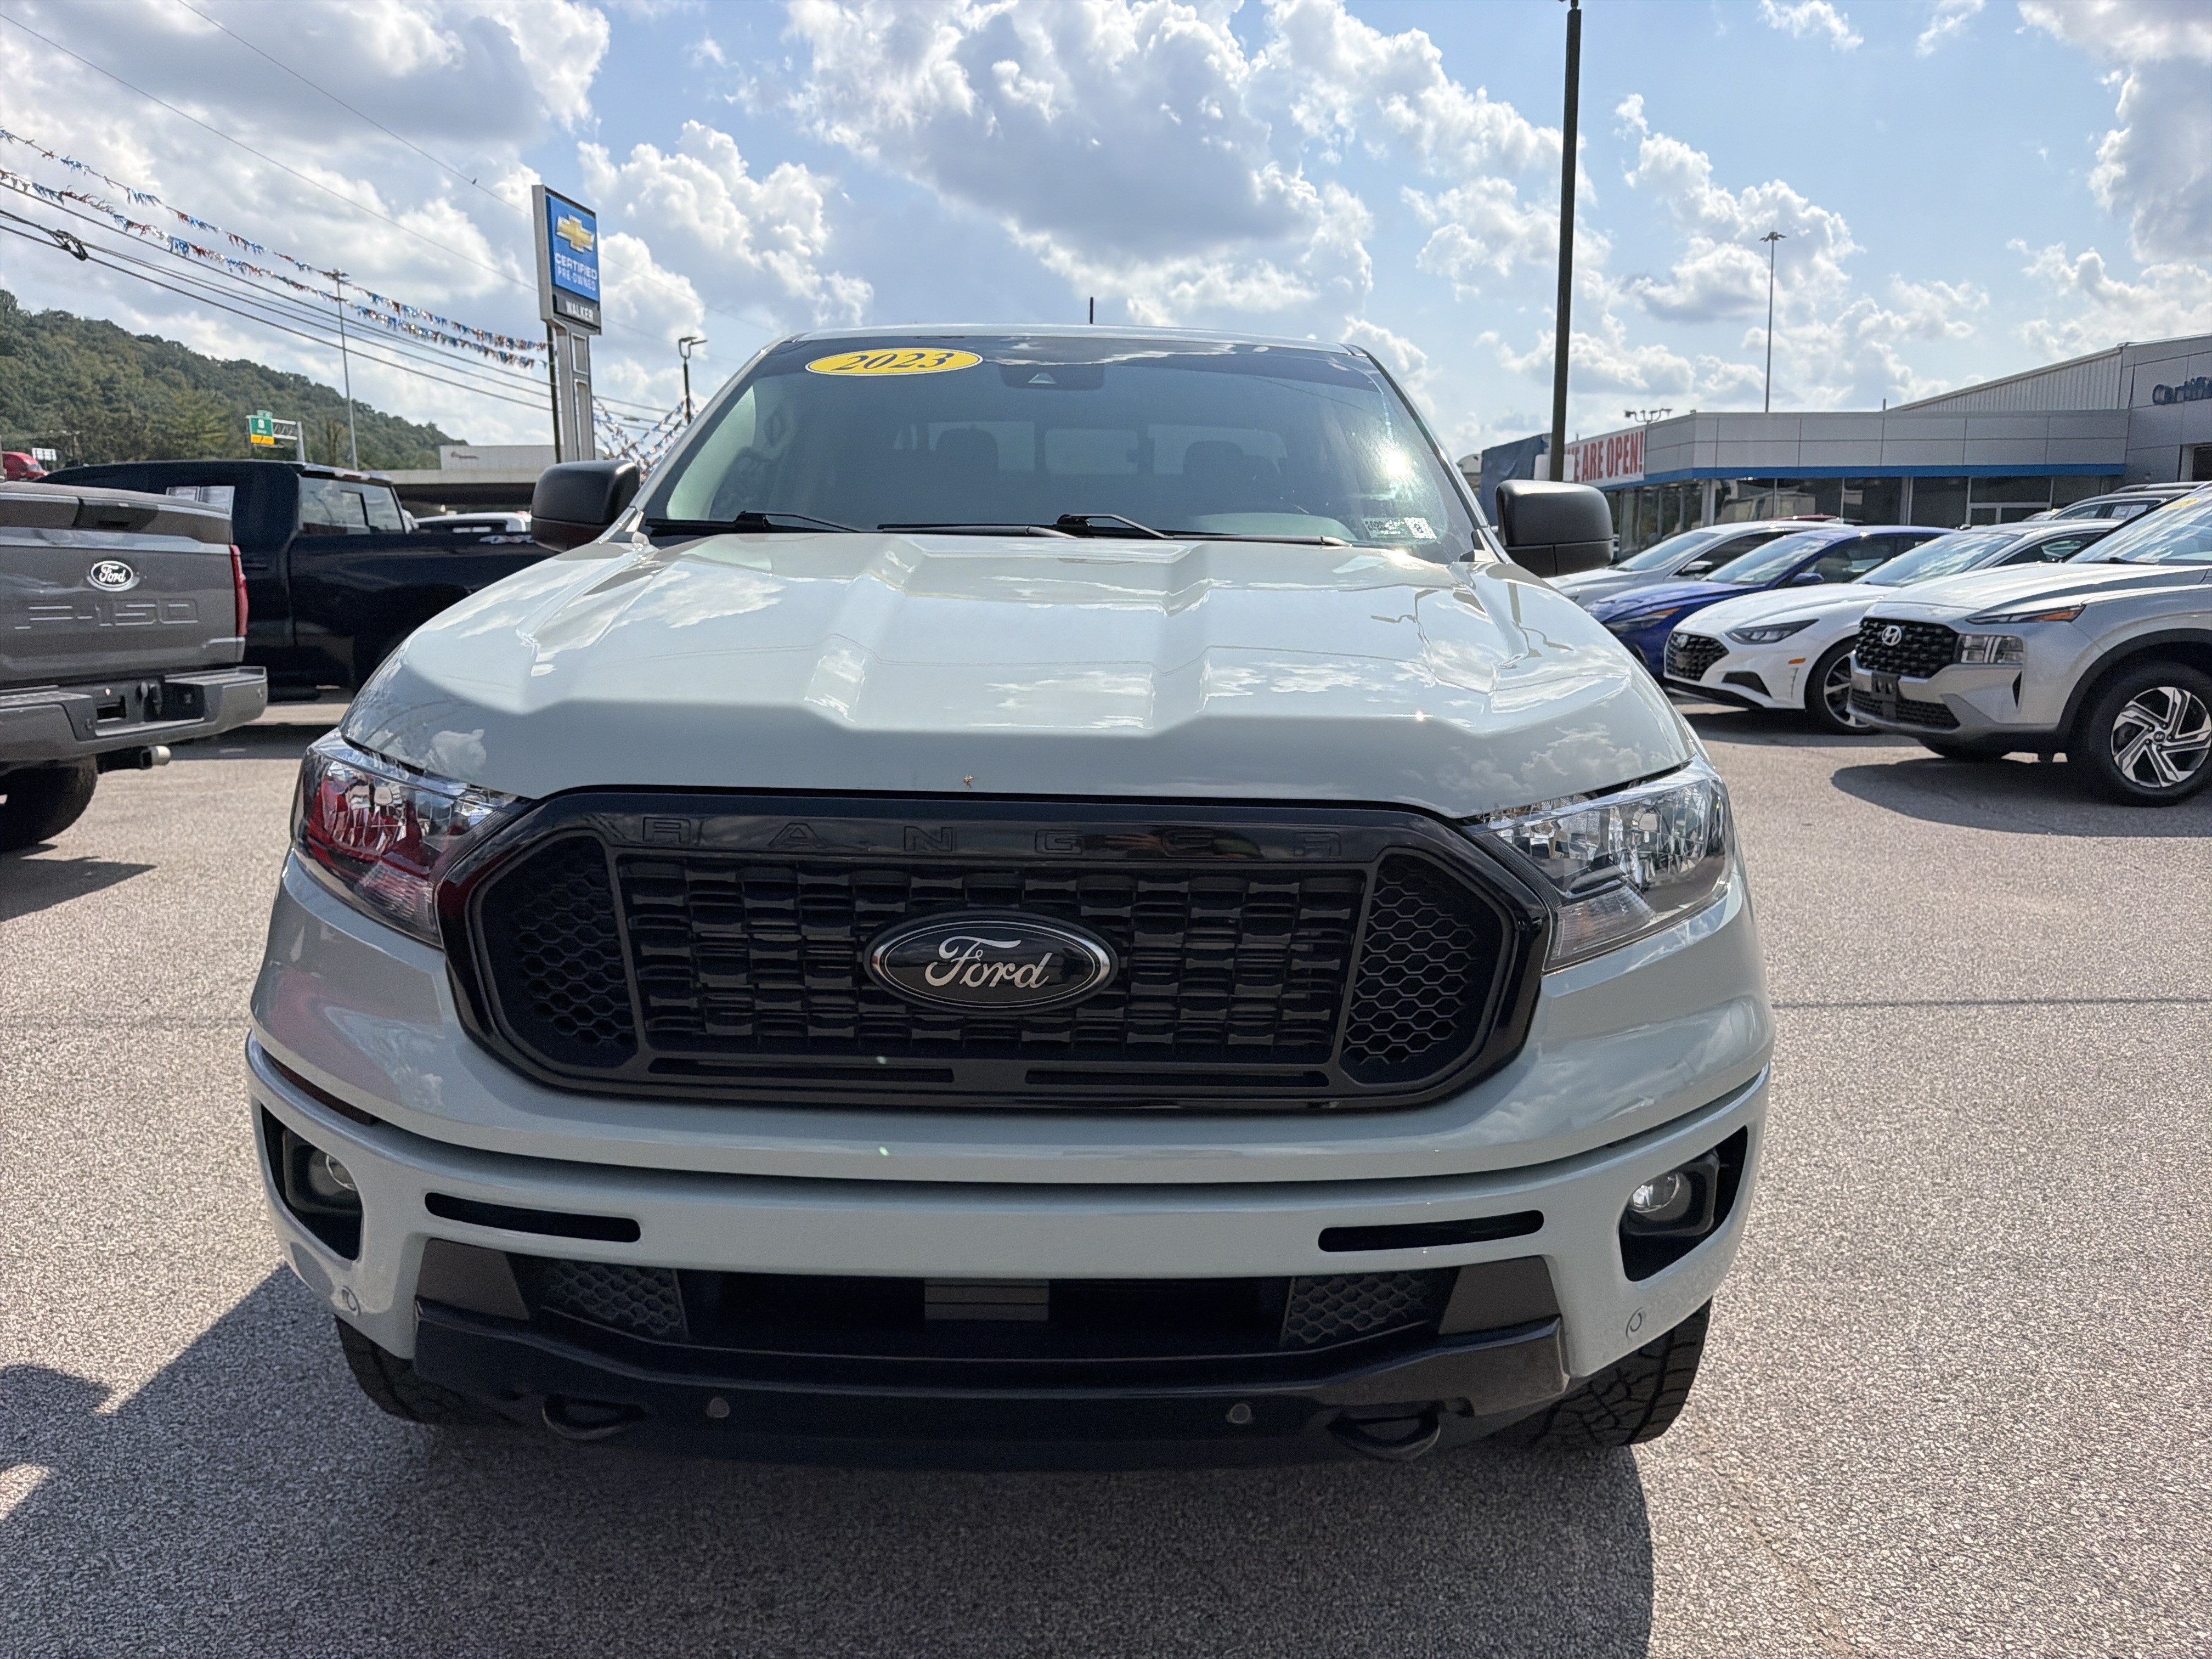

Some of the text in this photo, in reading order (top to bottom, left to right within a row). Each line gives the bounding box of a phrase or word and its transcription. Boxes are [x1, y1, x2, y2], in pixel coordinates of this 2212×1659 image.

[555, 252, 597, 280] CERTIFIED
[566, 300, 594, 323] WALKER
[831, 353, 955, 371] 2023
[1582, 441, 1603, 482] ARE
[1607, 431, 1644, 478] OPEN!
[99, 563, 127, 583] Ford
[15, 597, 199, 629] F-150
[642, 817, 1341, 859] RANGER
[925, 935, 1053, 989] Ford
